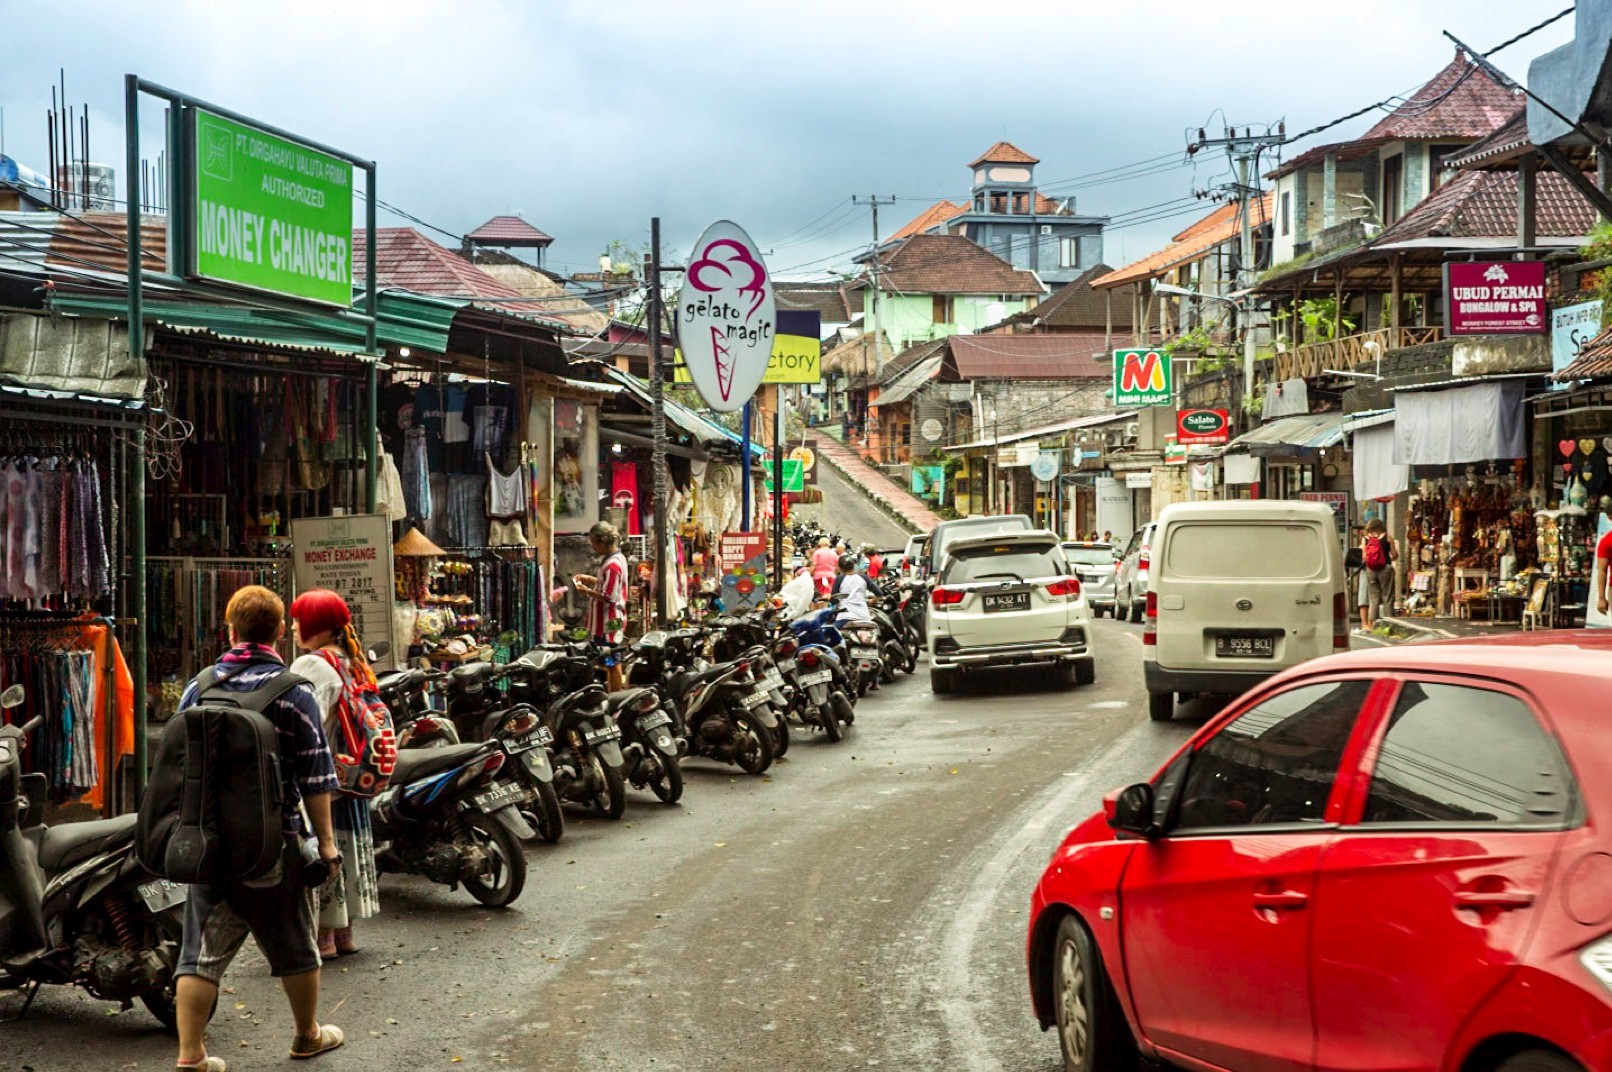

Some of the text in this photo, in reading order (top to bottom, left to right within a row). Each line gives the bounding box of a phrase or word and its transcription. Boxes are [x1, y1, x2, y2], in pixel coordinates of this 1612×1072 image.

[297, 153, 323, 177] VALUTA
[325, 163, 348, 187] PRIMA
[261, 174, 325, 208] AUTHORIZED
[201, 199, 347, 284] MONEY CHANGER
[1453, 285, 1543, 300] UBUD PERMAI
[1460, 301, 1537, 313] BUNGALOW & SPA
[727, 319, 770, 347] magic
[1118, 394, 1169, 403] MINI MART
[305, 548, 376, 563] MONEY EXCHANGE
